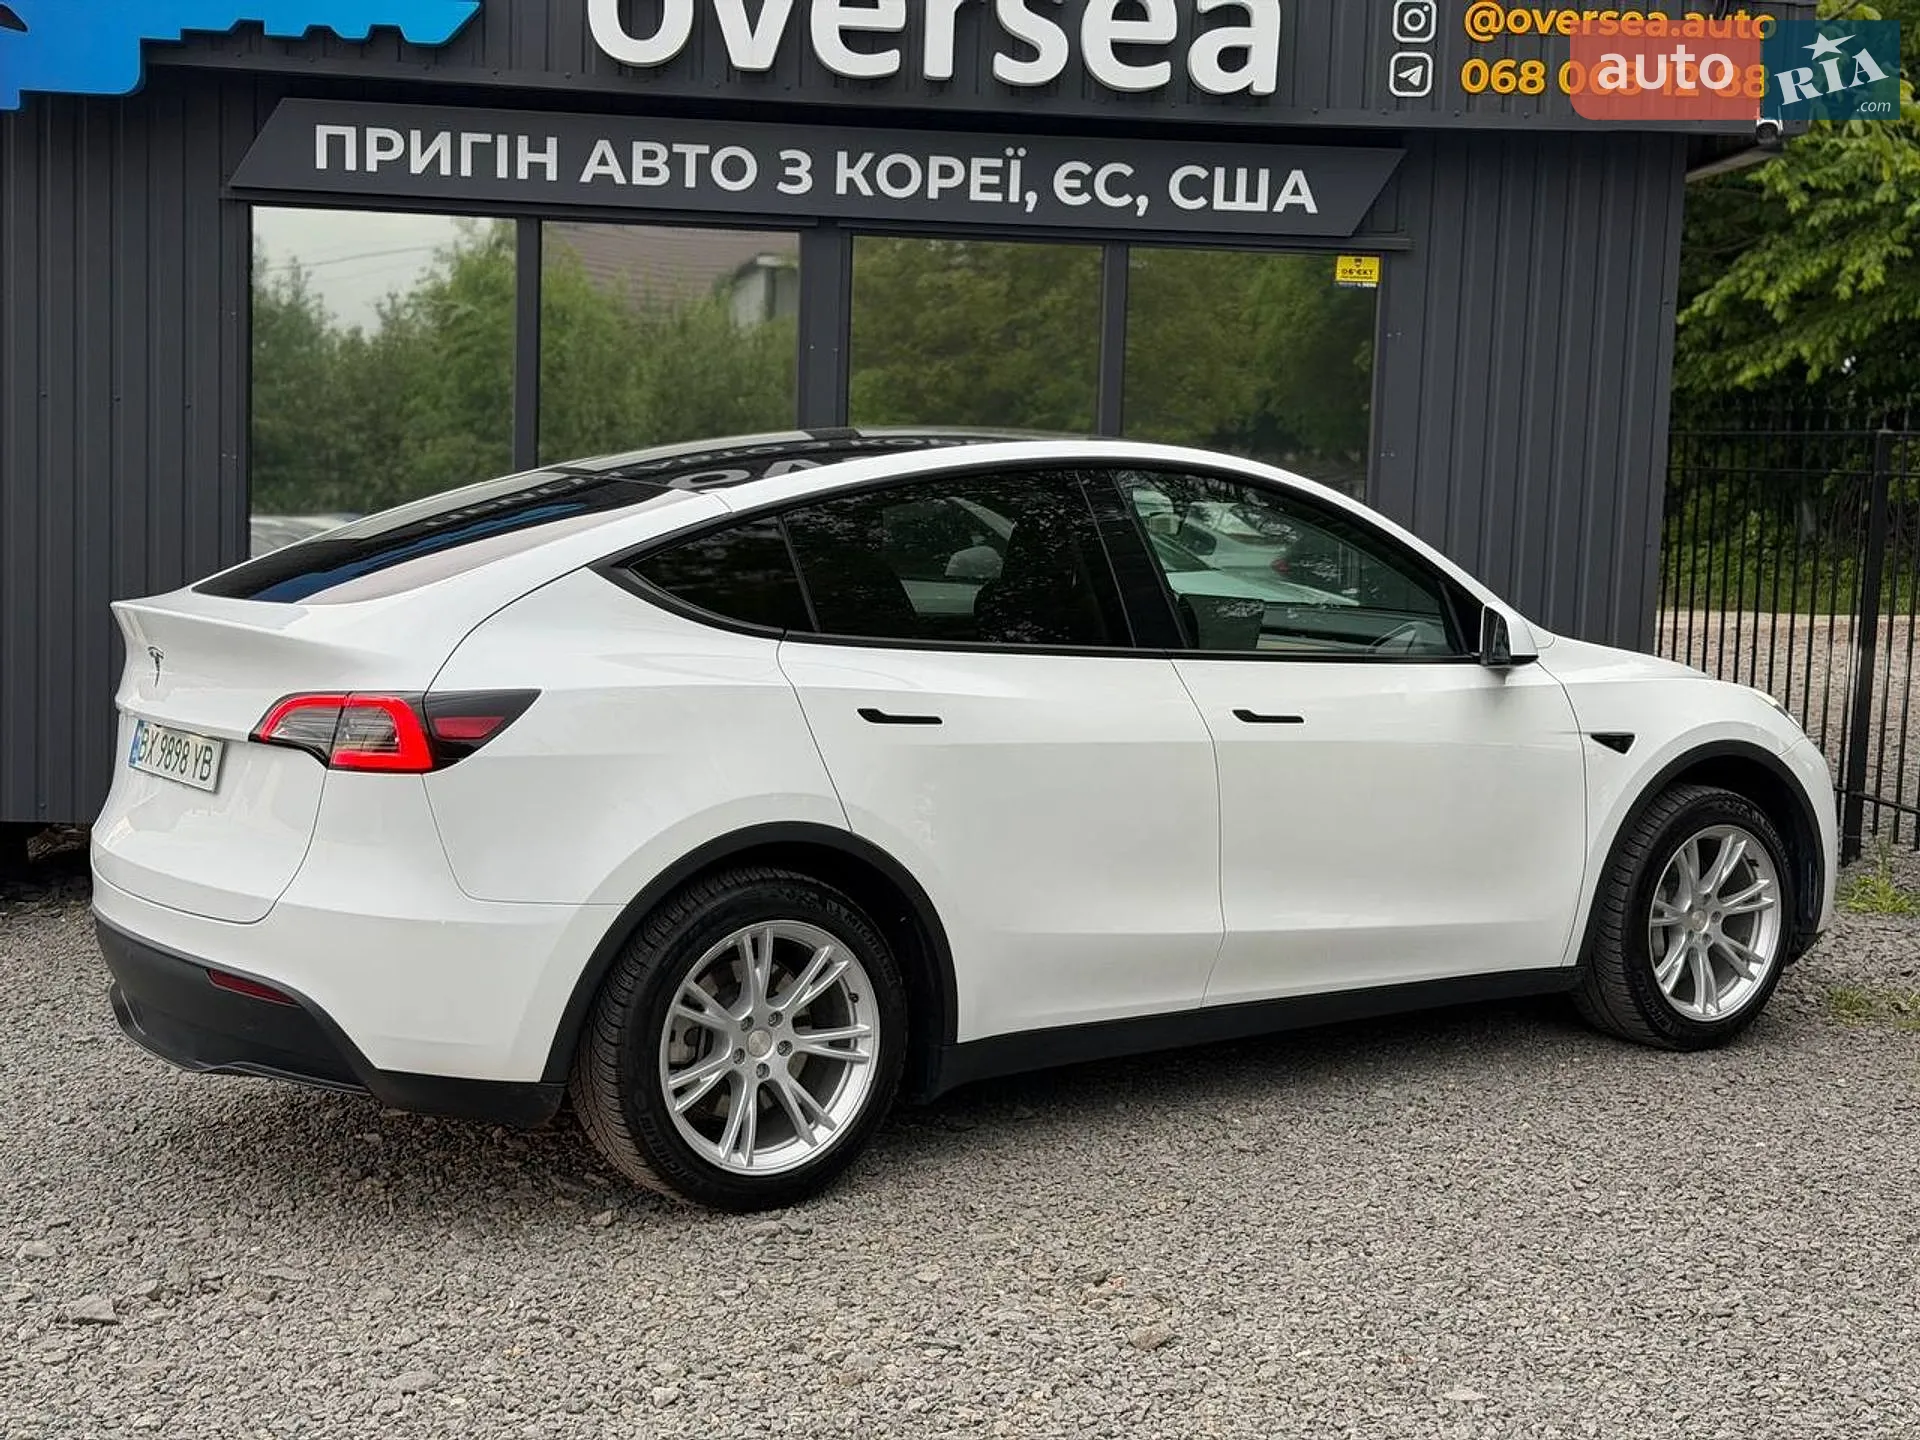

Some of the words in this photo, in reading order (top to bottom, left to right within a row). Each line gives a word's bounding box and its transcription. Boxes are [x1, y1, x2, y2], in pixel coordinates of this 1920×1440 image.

[1464, 1, 1777, 42] @oversea.auto
[588, 0, 1281, 98] oversea
[1461, 58, 1546, 95] 068
[315, 124, 558, 182] ПРИГІН
[579, 139, 758, 192] АВТО
[776, 149, 814, 195] З
[835, 147, 1038, 212] КОРЕЇ,
[1053, 160, 1149, 217] ЄС,
[1168, 165, 1318, 214] США
[138, 728, 160, 765] BX
[156, 733, 190, 775] 9898
[192, 743, 213, 782] YB
